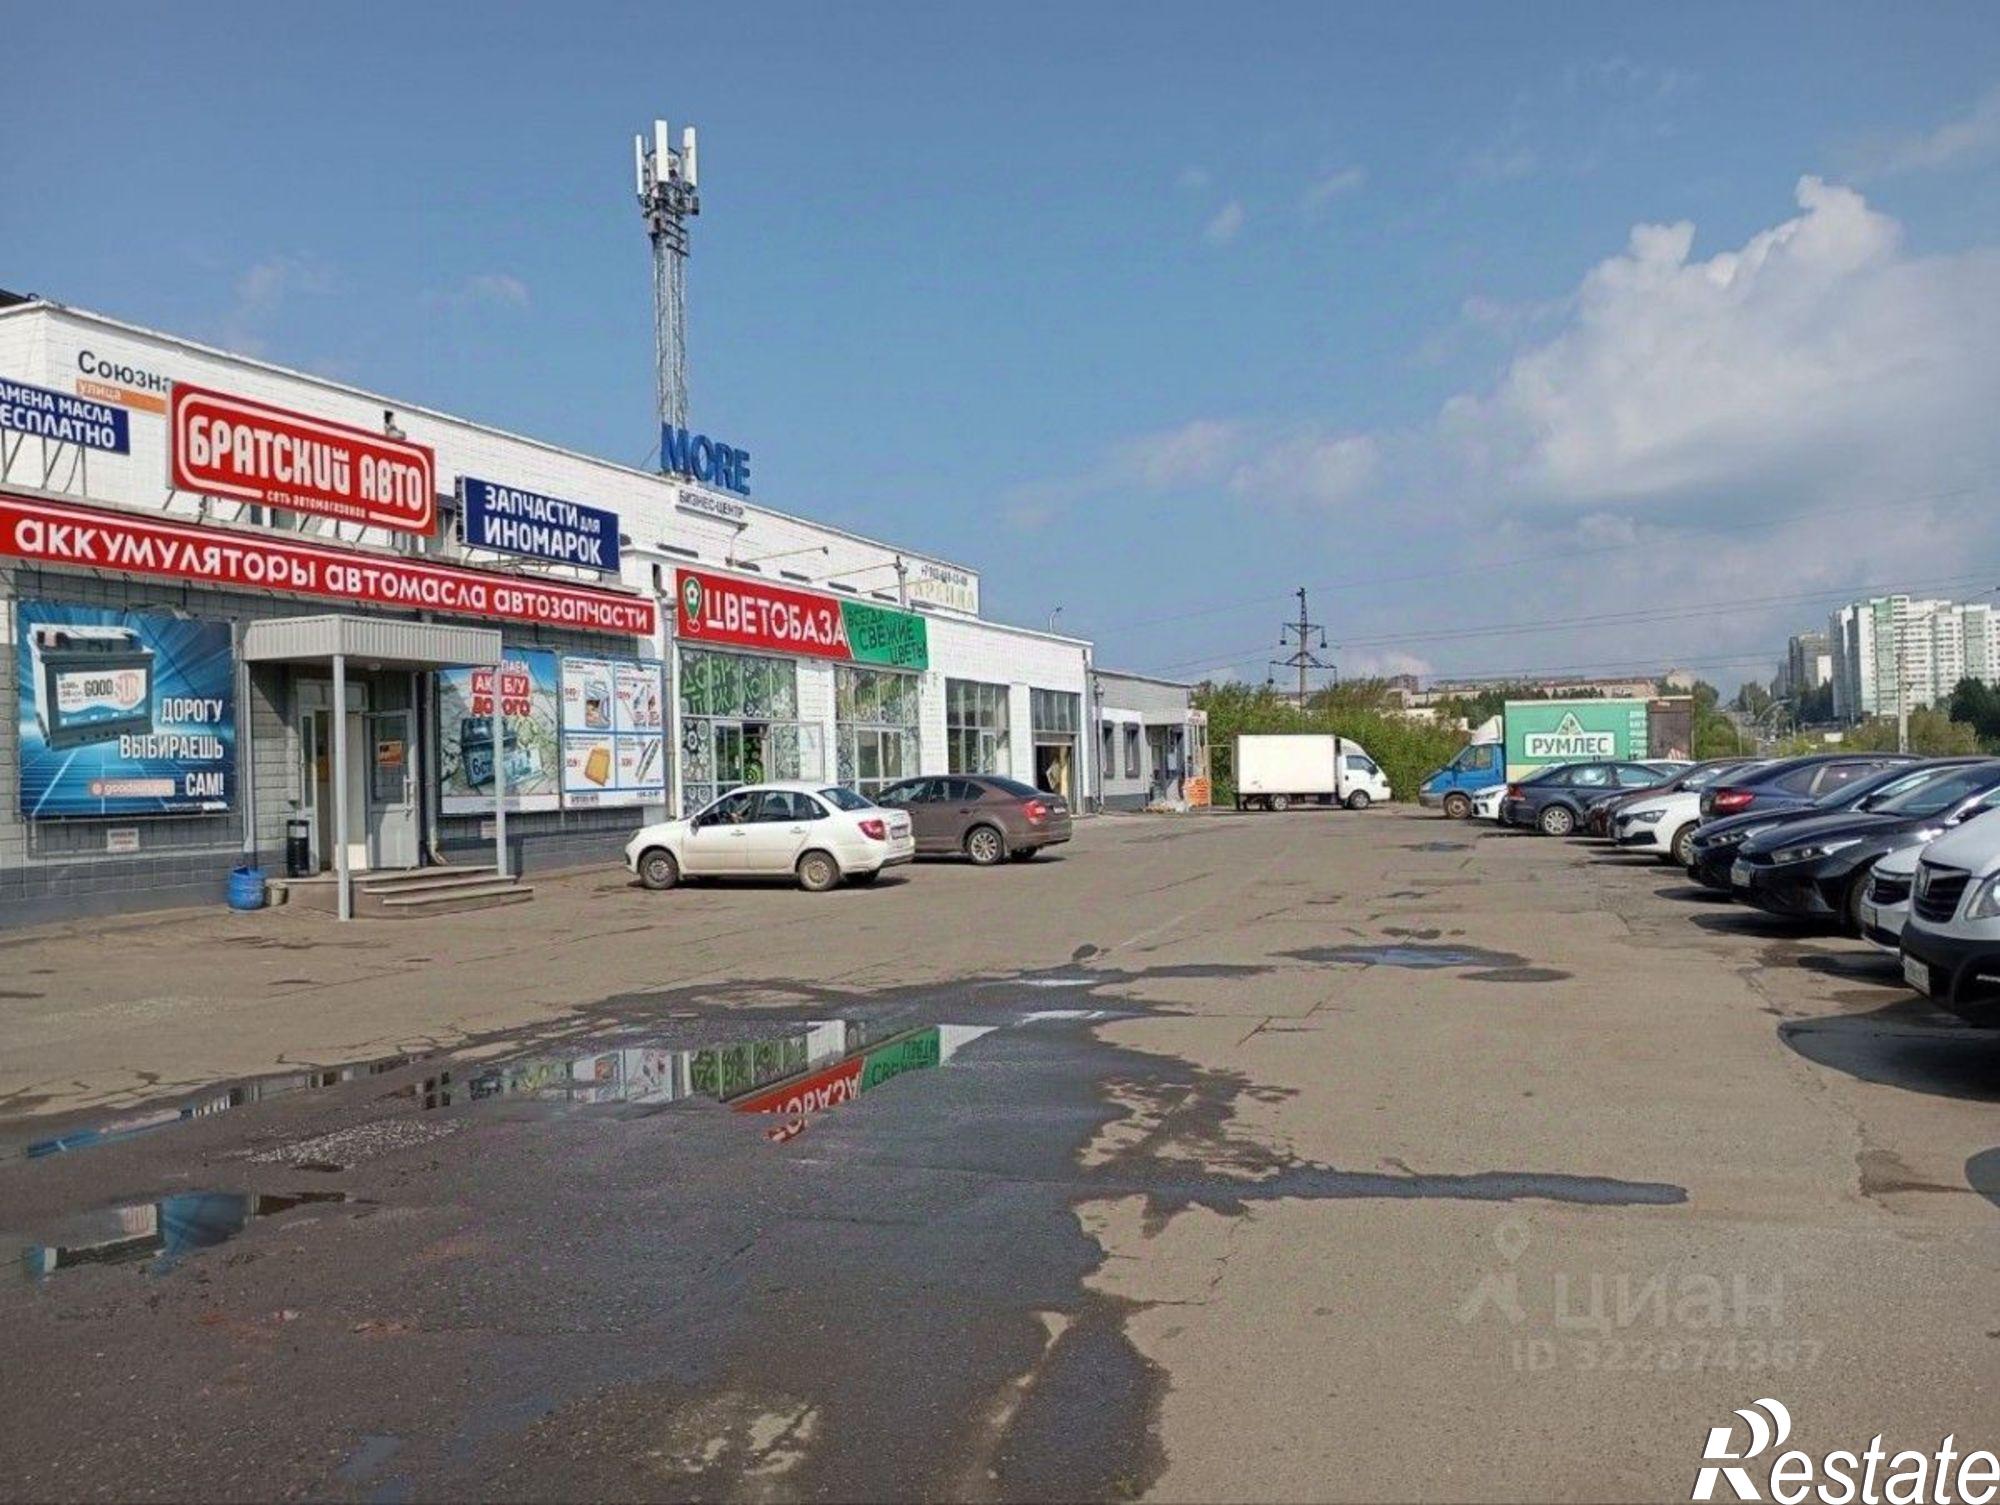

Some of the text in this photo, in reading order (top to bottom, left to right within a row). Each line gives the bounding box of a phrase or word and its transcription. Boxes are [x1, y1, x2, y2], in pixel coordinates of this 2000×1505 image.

[59, 398, 114, 426] МАСЛА
[188, 415, 423, 511] БРАТСКИЙ АВТО
[661, 421, 750, 496] MORE
[484, 485, 578, 528] ЗАПЧАСТИ
[484, 515, 603, 565] ИНОМАРОК
[15, 518, 648, 630] аккумуляторы автомасла автозапчасти
[704, 588, 848, 648] ЦВЕТОБАЗА
[858, 619, 914, 651] СВЕЖИЕ
[889, 640, 928, 665] ЦВЕТЫ
[161, 698, 223, 724] ДОРОГУ
[119, 734, 224, 760] ВЫБИРАЕШЬ
[1532, 737, 1608, 754] РУМЛЕС
[185, 772, 224, 796] САМ!
